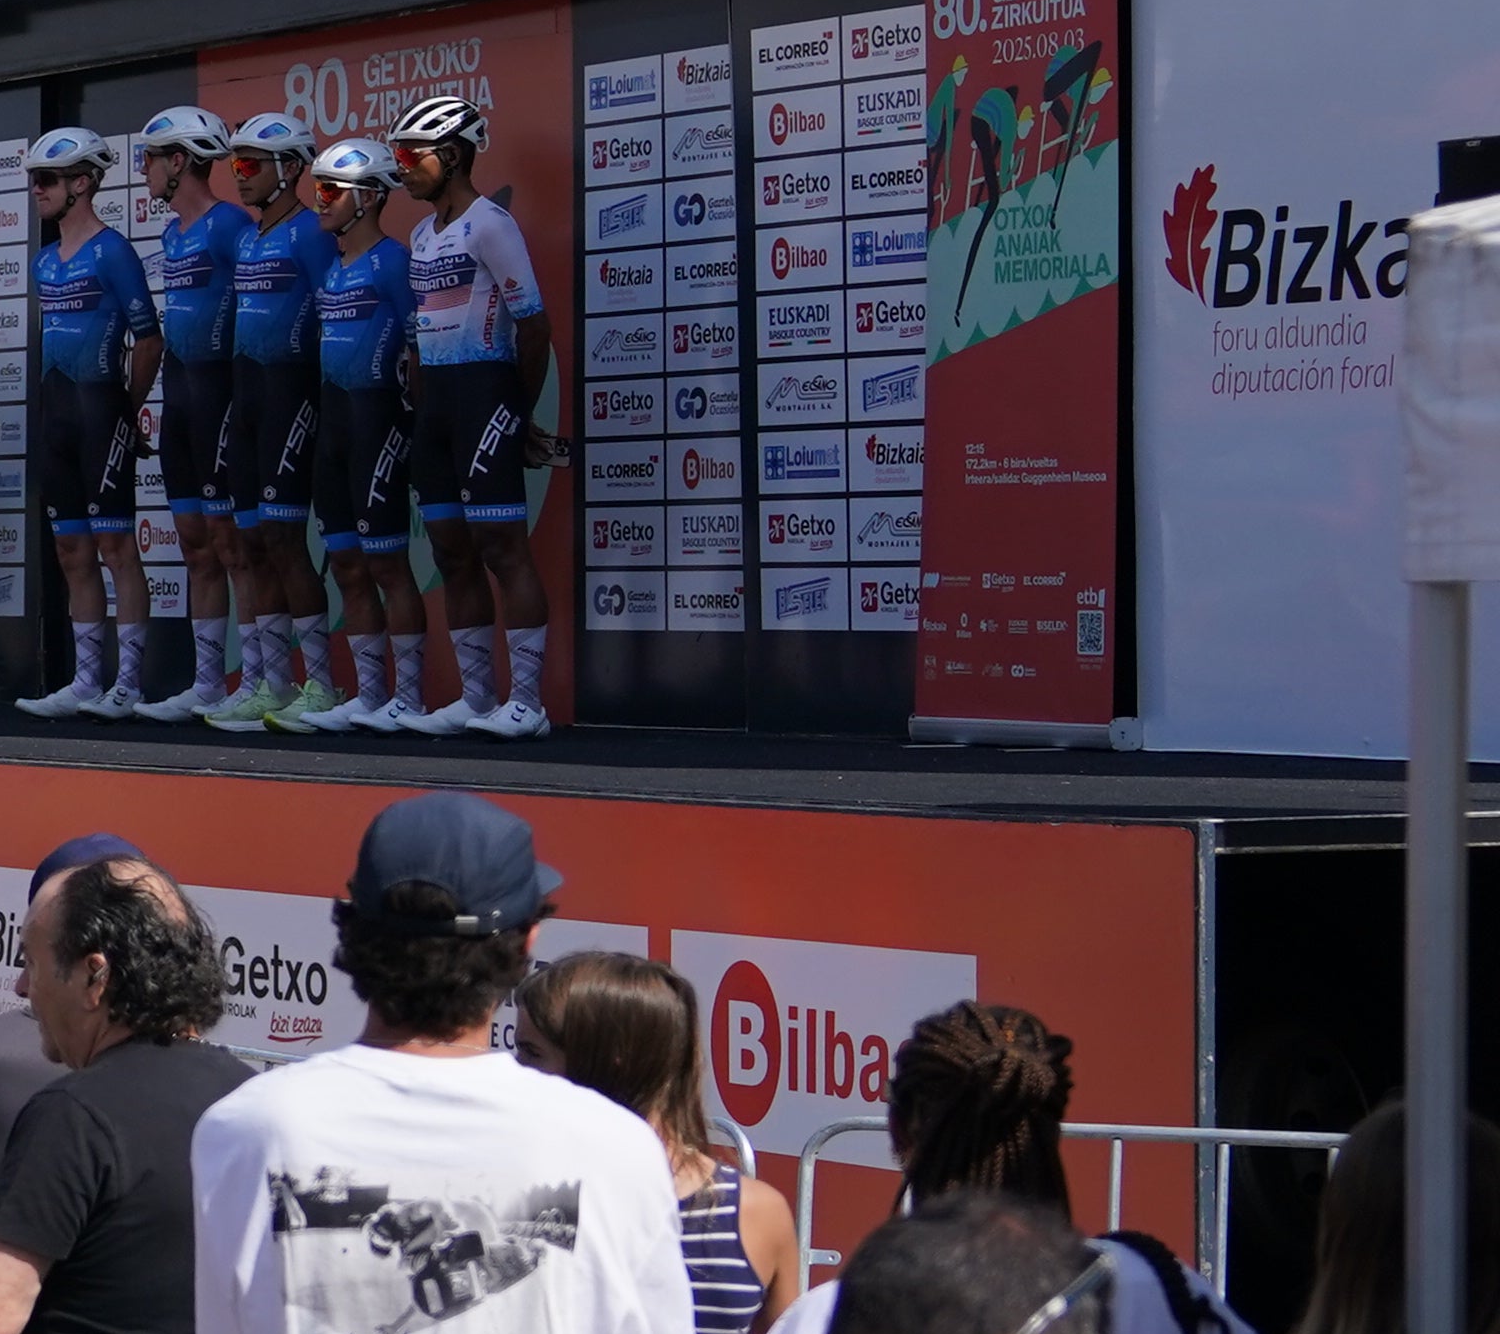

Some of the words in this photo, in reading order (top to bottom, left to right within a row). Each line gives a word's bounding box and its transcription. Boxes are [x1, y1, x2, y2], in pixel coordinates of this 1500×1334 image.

[871, 24, 921, 48] Getxo
[363, 38, 482, 88] GETXOKO
[759, 48, 774, 64] EL
[776, 40, 828, 61] CORREO
[685, 61, 730, 85] Bizkaia
[285, 57, 358, 136] 80.
[858, 88, 921, 113] EUSKADI
[773, 107, 825, 134] Bilbao
[610, 137, 652, 160] Getxo
[782, 173, 830, 196] Getxo
[852, 174, 867, 190] EL
[870, 168, 923, 188] CORREO
[150, 199, 172, 213] Get
[995, 229, 1061, 258] ANAIAK
[1213, 200, 1409, 308] Bizka
[776, 246, 827, 270] Bilbao
[995, 252, 1111, 284] MEMORIALA
[608, 267, 653, 288] Bizkaia
[675, 266, 687, 281] EL
[690, 260, 737, 280] CORREO
[769, 303, 830, 326] EUSKADI
[876, 300, 925, 323] Getxo
[691, 323, 734, 345] Getxo
[1213, 320, 1257, 357] foru
[1265, 312, 1367, 350] aldundia
[1212, 358, 1333, 400] diputación
[1341, 354, 1394, 394] foral
[610, 391, 653, 414] Getxo
[468, 404, 512, 478] TSG
[367, 426, 403, 508] TSG
[591, 464, 604, 479] EL
[607, 462, 654, 478] CORREO
[687, 457, 734, 480] Bilbao
[464, 505, 526, 518] SHIMANO
[610, 521, 654, 542] Getxo
[683, 515, 739, 534] EUSKADI
[788, 514, 835, 536] Getxo
[362, 535, 408, 550] SHIMA
[674, 594, 689, 609] EL
[691, 593, 739, 609] CORREO
[881, 581, 920, 605] Getx
[220, 936, 327, 1005] Getxo
[726, 999, 892, 1104] Bilba
